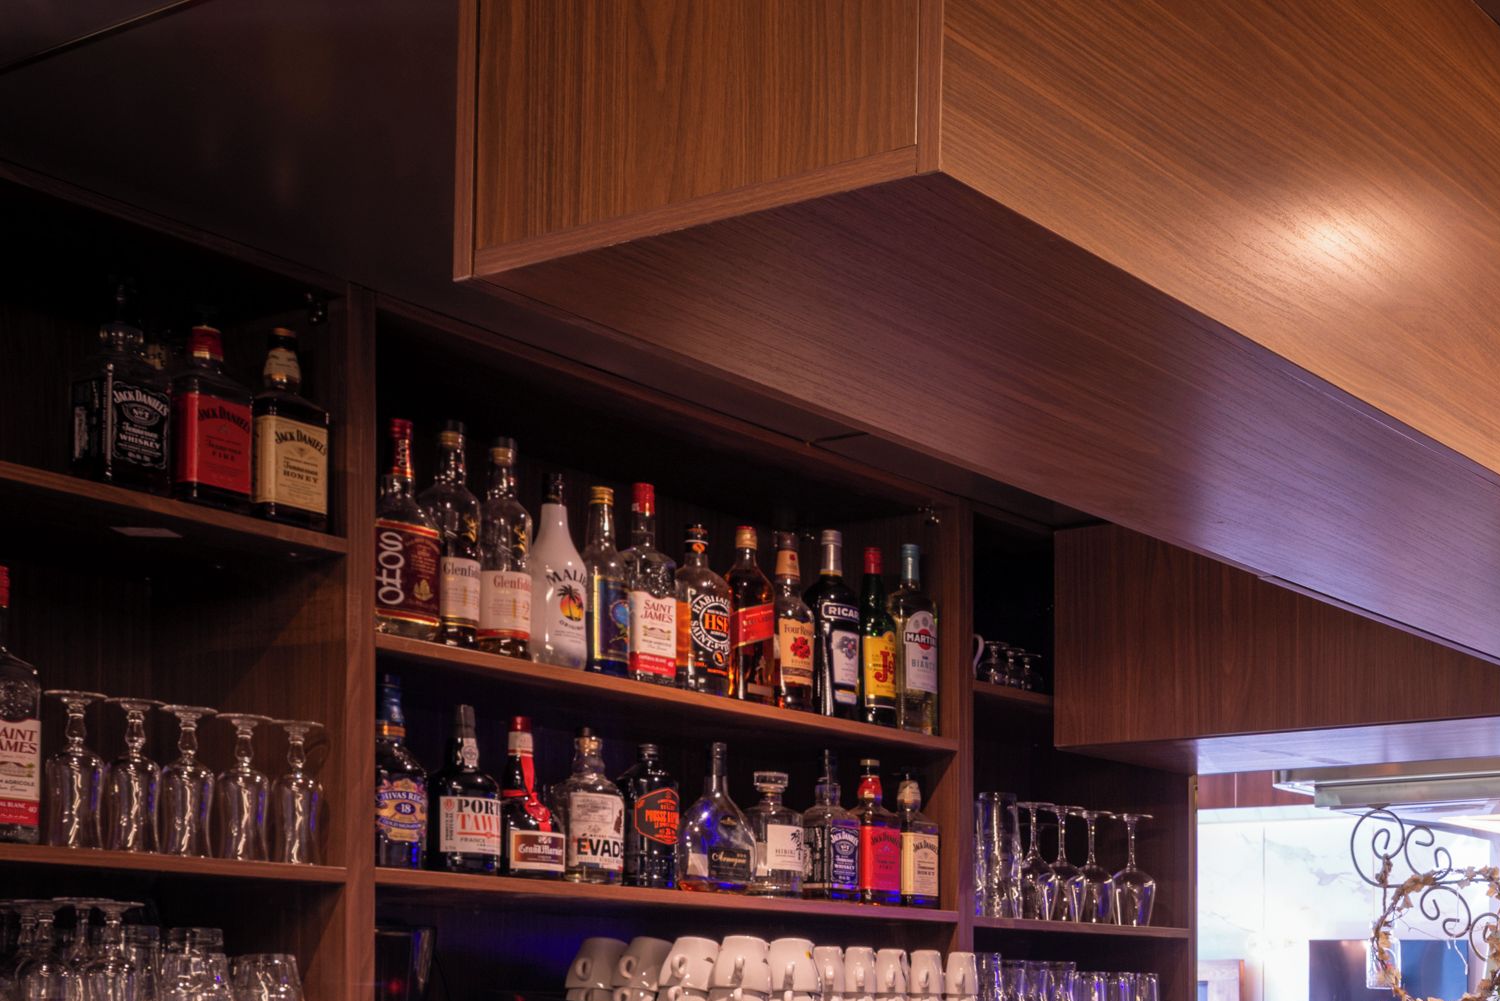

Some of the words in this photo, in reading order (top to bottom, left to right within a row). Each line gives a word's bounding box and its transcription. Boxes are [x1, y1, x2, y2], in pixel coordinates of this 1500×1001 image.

[113, 390, 136, 404] JACK
[199, 407, 219, 421] JACK
[119, 433, 161, 449] WHISKEY
[275, 430, 295, 444] JACK
[296, 429, 327, 456] DANIEL'S
[283, 470, 318, 483] HONEY
[643, 600, 673, 614] SAINT
[640, 610, 673, 624] JAMES
[0, 727, 37, 741] AINT
[0, 740, 37, 755] AMES
[400, 803, 412, 814] 18
[456, 813, 501, 831] TAW
